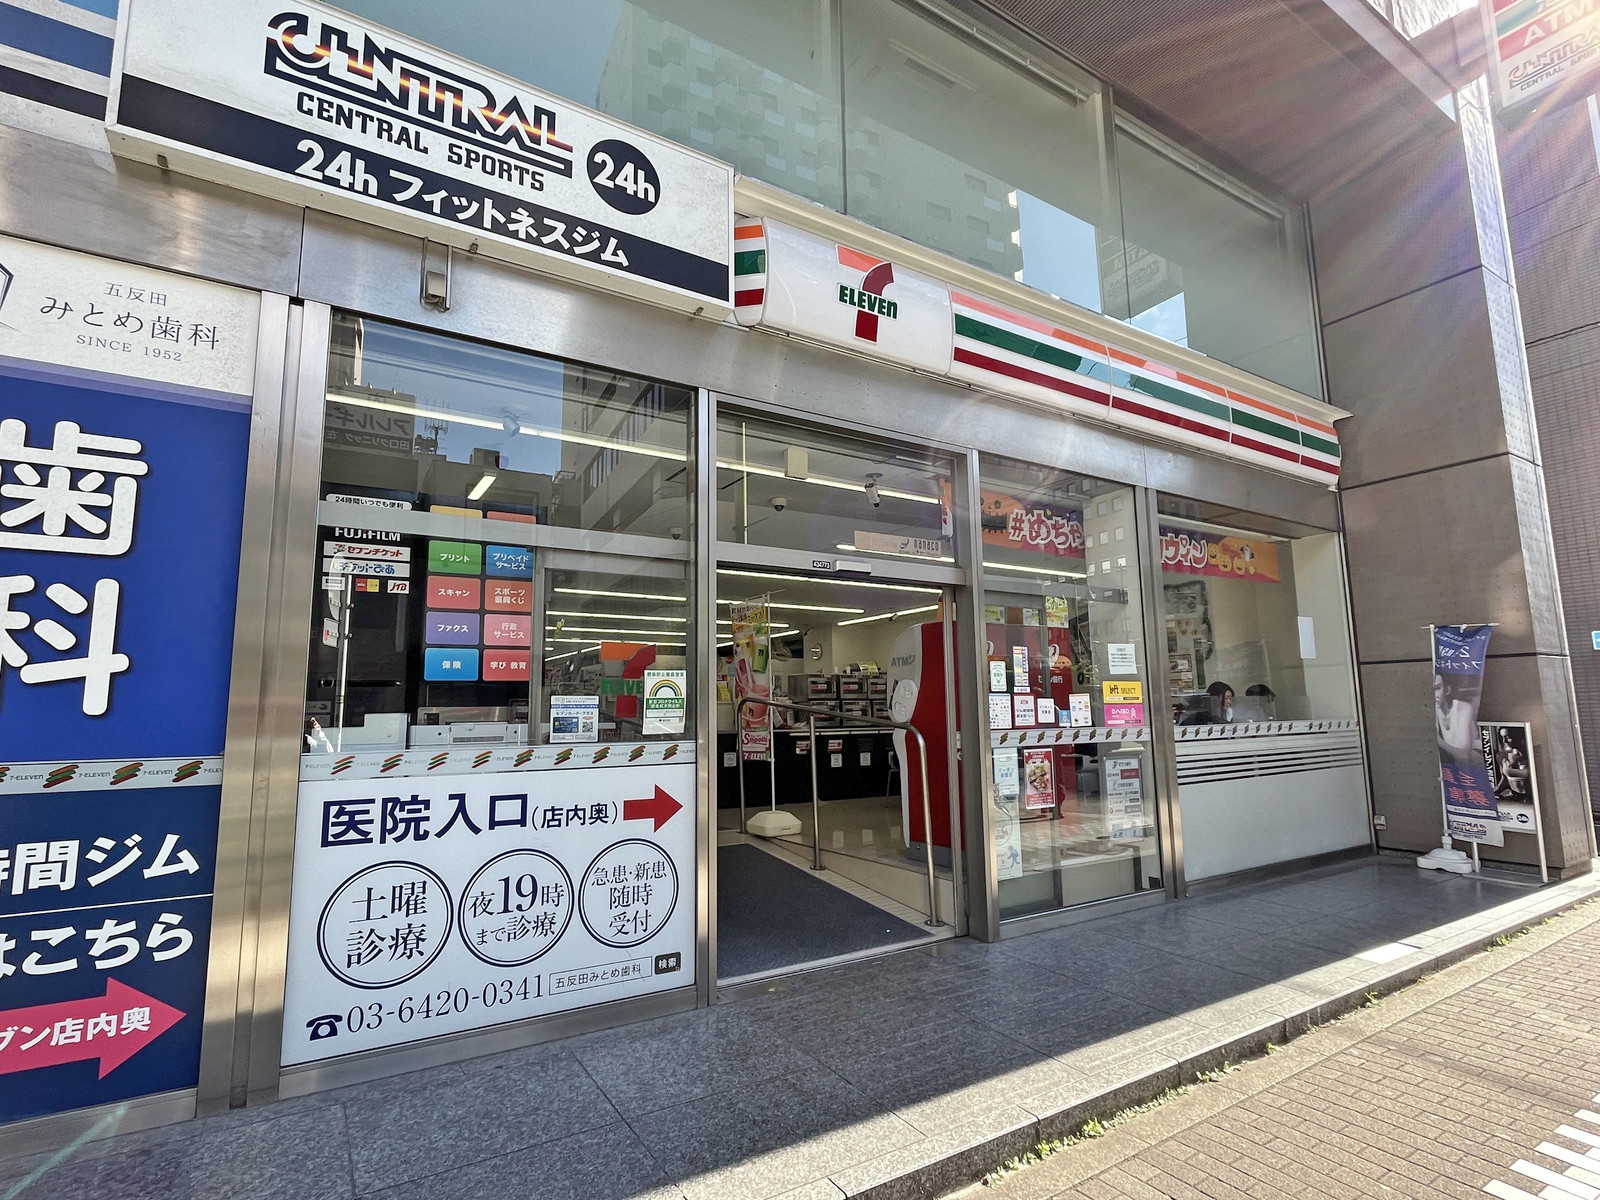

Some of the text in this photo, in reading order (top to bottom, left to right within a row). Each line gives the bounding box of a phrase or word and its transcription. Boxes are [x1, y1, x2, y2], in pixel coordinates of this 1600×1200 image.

[1520, 66, 1564, 91] CENTRAL
[297, 91, 545, 192] CENTRAL SPORTS
[593, 152, 655, 205] 24h
[294, 139, 630, 267] 24h フィットネスジム
[105, 282, 168, 308] 五反田
[39, 295, 220, 352] みとめ歯科
[76, 334, 183, 363] SINCE 1952
[440, 553, 470, 562] プリント
[913, 539, 939, 551] nanaco
[1160, 533, 1208, 568] ウィン
[438, 588, 471, 597] スキャン
[437, 624, 469, 633] ファクス
[442, 660, 463, 670] 保険
[319, 792, 619, 849] 医院入口 (店内奥)
[591, 860, 667, 887] 急患・新患
[348, 880, 429, 926] 土曜
[468, 873, 565, 919] 夜19時
[609, 883, 653, 910] 随時
[475, 911, 557, 947] まで診療
[608, 910, 652, 938] 受付
[345, 922, 428, 970] 診療
[554, 962, 642, 990] 五反田みとめ歯科
[346, 974, 544, 1034] 03-6420-0341
